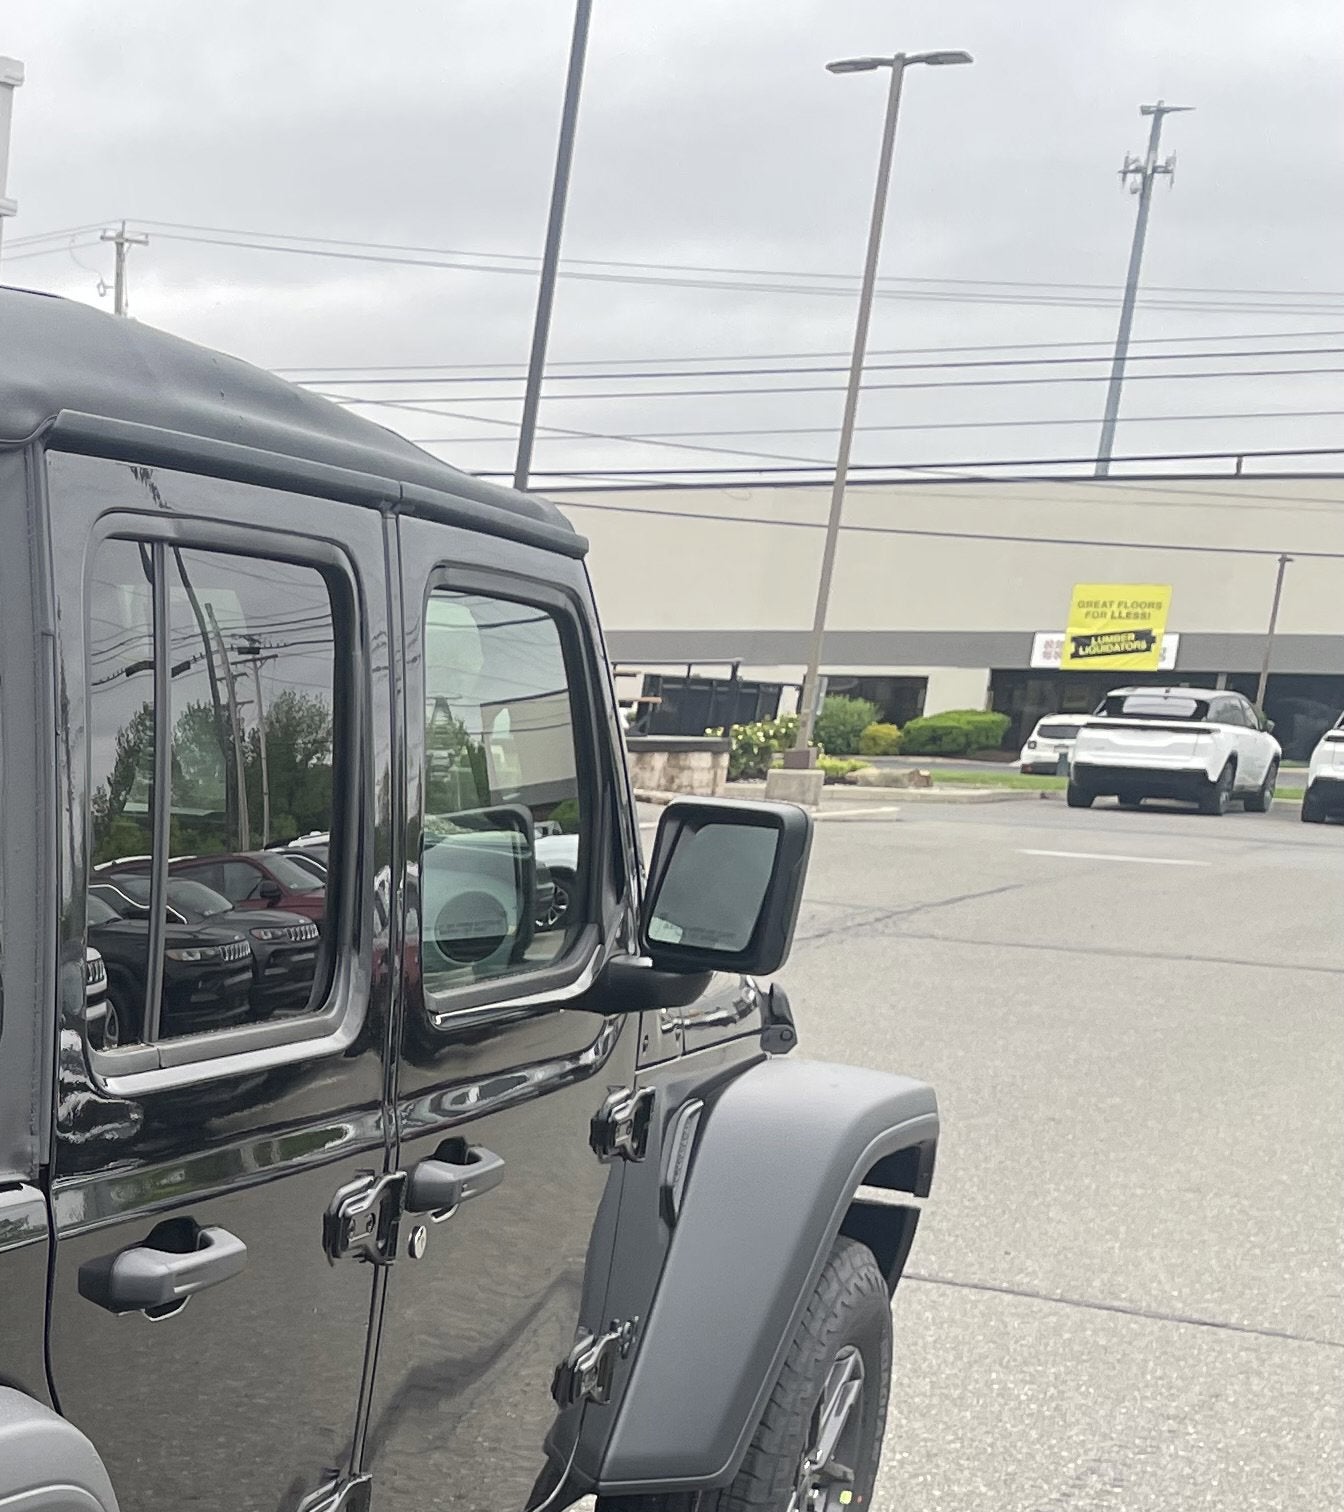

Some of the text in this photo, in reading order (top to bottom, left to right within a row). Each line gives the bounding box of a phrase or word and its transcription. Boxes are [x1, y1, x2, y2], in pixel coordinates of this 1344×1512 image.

[1077, 600, 1162, 610] GREAT FLOORS
[1084, 610, 1151, 620] FOR LLESS!
[1091, 632, 1135, 644] LUMBER
[1078, 639, 1147, 656] LIQUIDATORS
